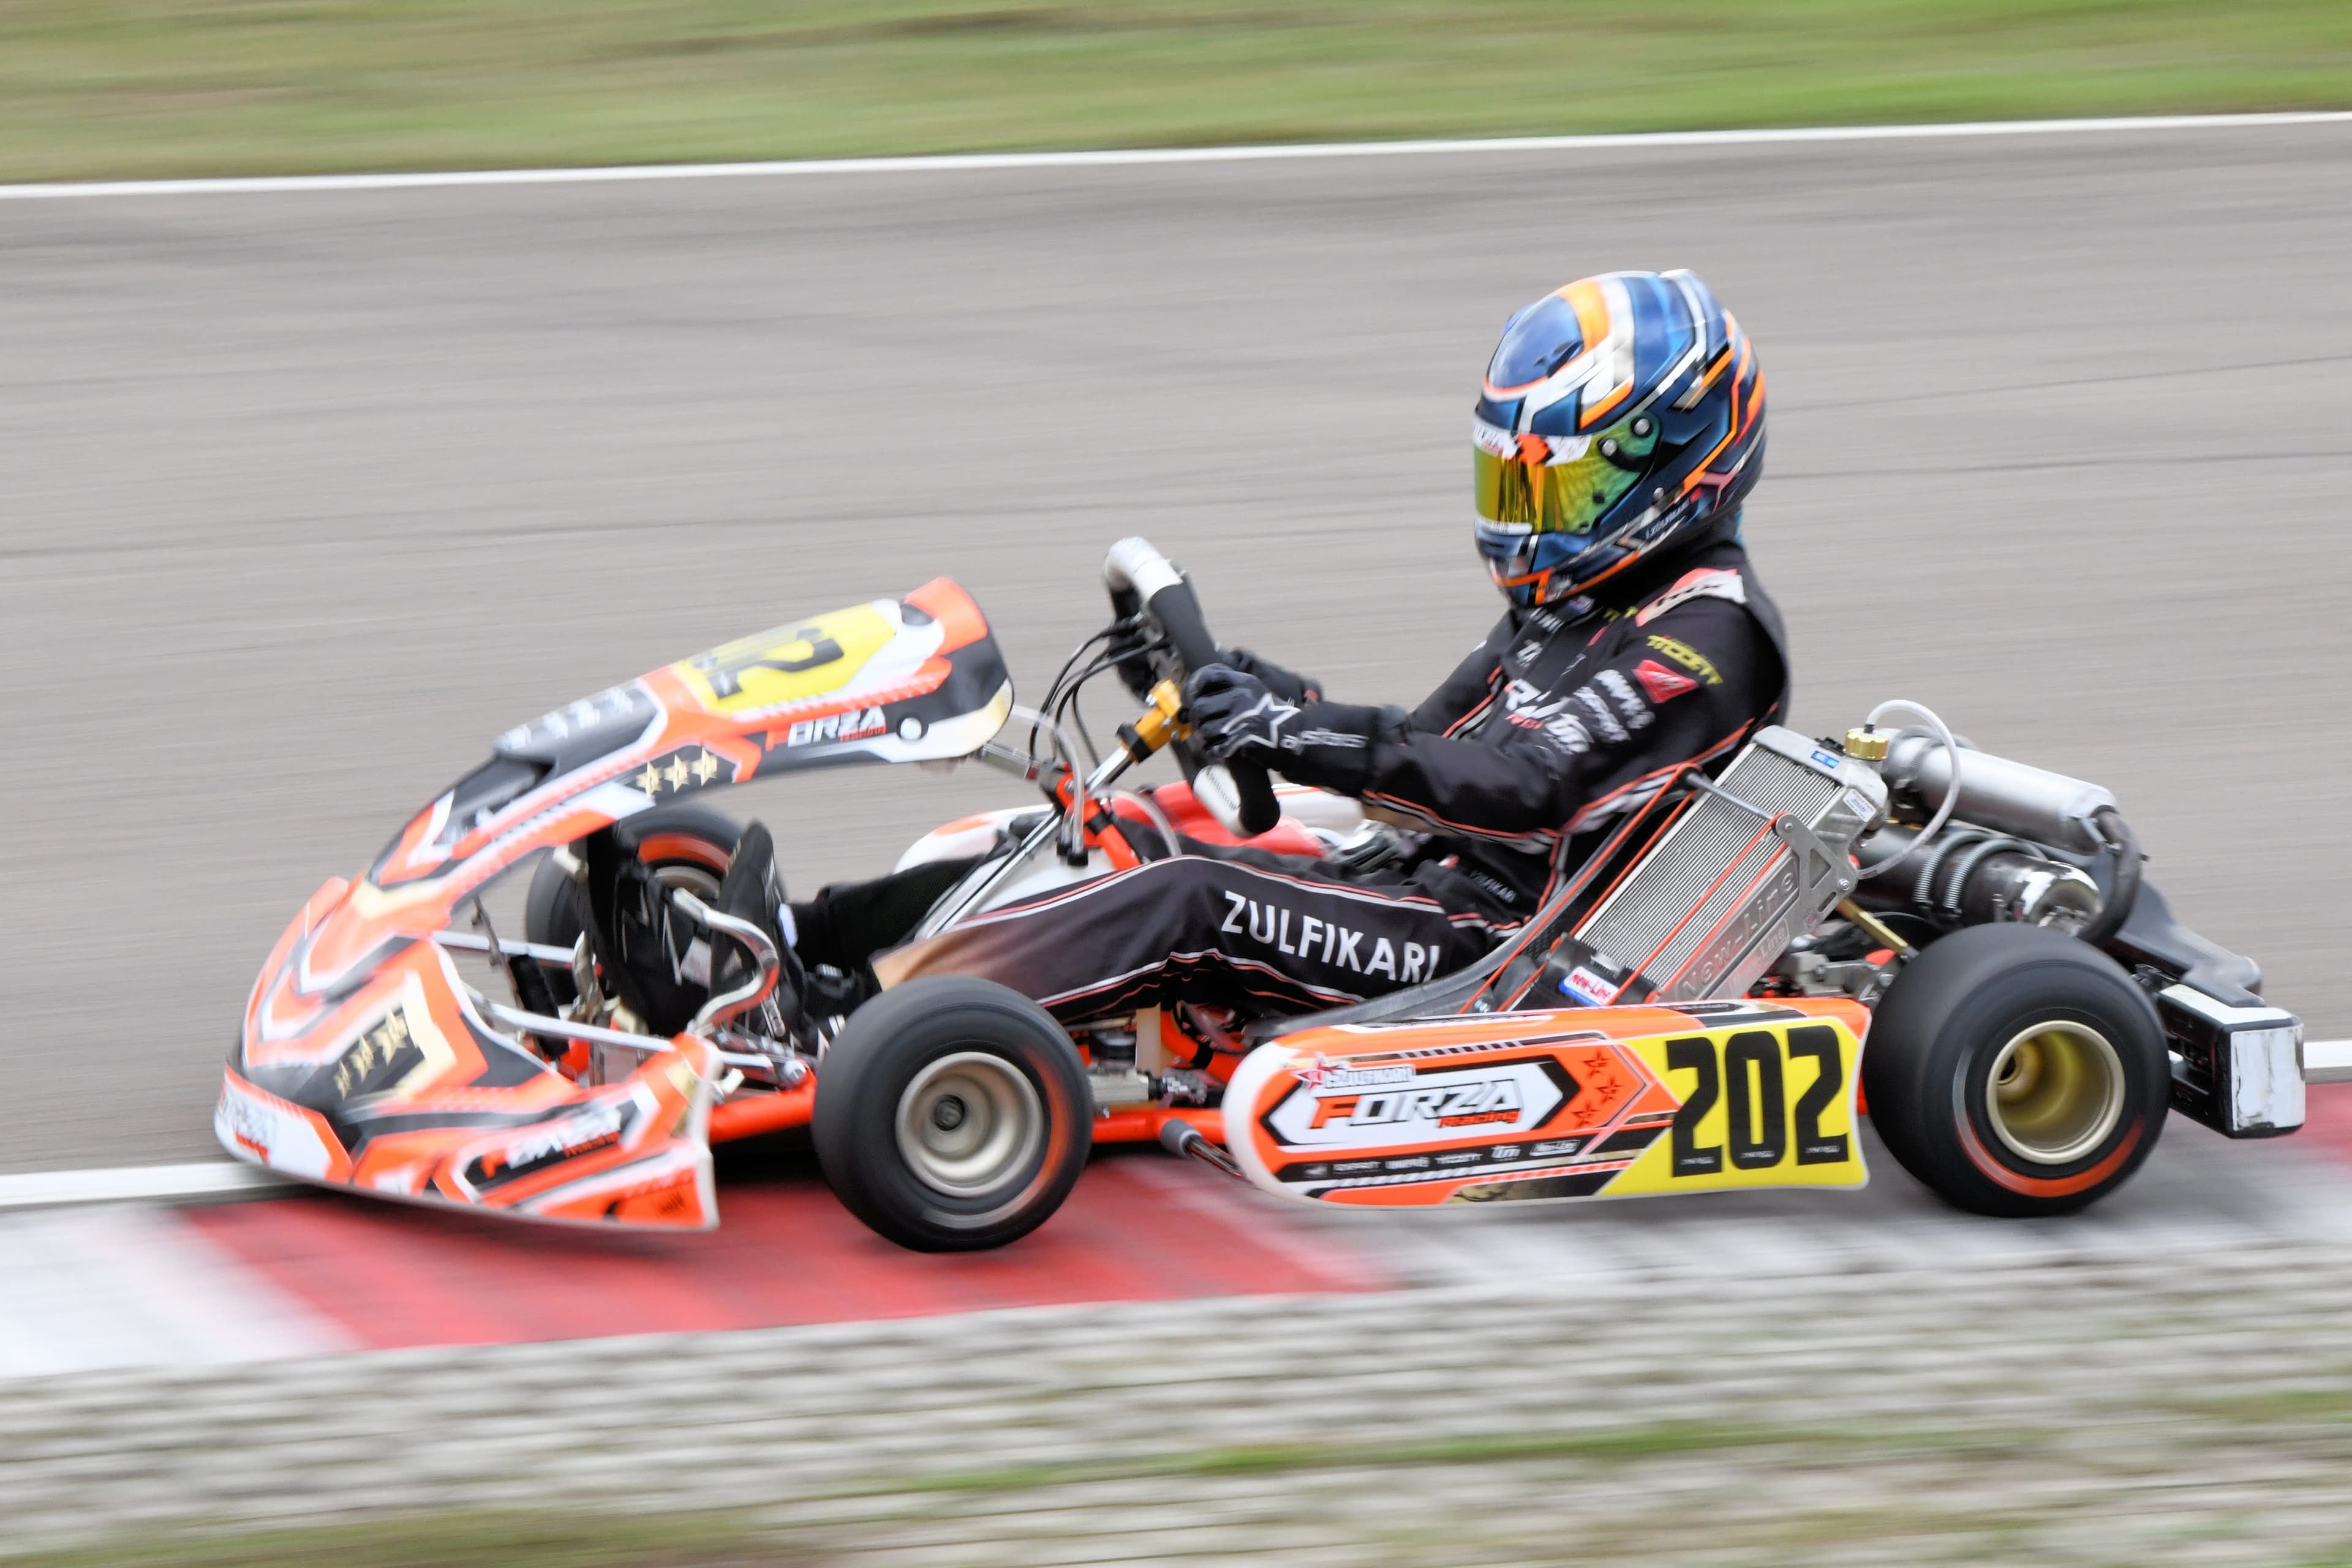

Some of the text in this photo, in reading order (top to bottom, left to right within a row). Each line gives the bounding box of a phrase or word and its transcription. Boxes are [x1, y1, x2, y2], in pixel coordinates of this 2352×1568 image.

[1221, 890, 1441, 984] ZULFIKARI
[1308, 1079, 1523, 1129] FORZA
[1665, 1025, 1849, 1178] 202
